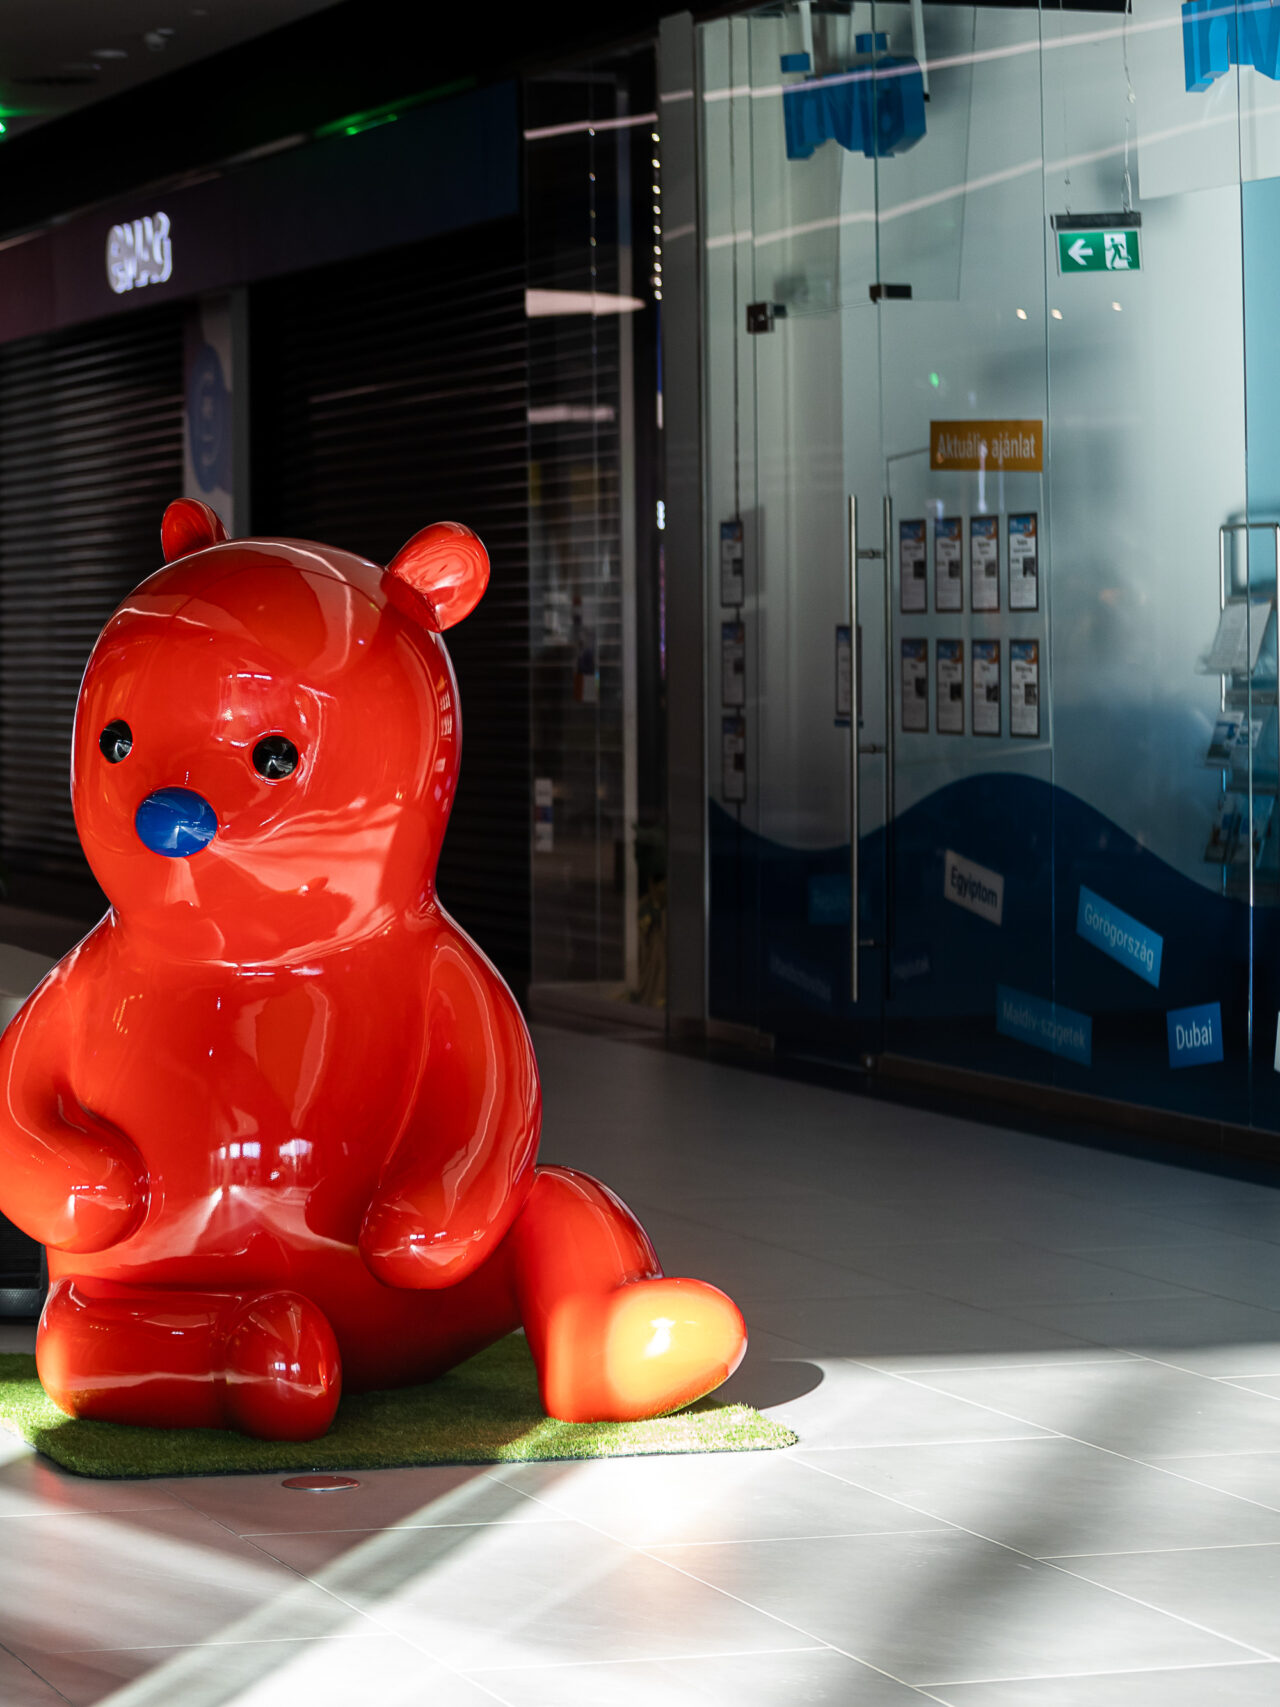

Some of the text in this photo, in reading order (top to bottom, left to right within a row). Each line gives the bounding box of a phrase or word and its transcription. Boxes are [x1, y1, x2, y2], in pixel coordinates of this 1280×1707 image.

[991, 431, 1036, 465] ajánlat
[950, 864, 998, 910] Egyiptom
[1084, 903, 1154, 973] Görögország
[1175, 1016, 1213, 1051] Dubai
